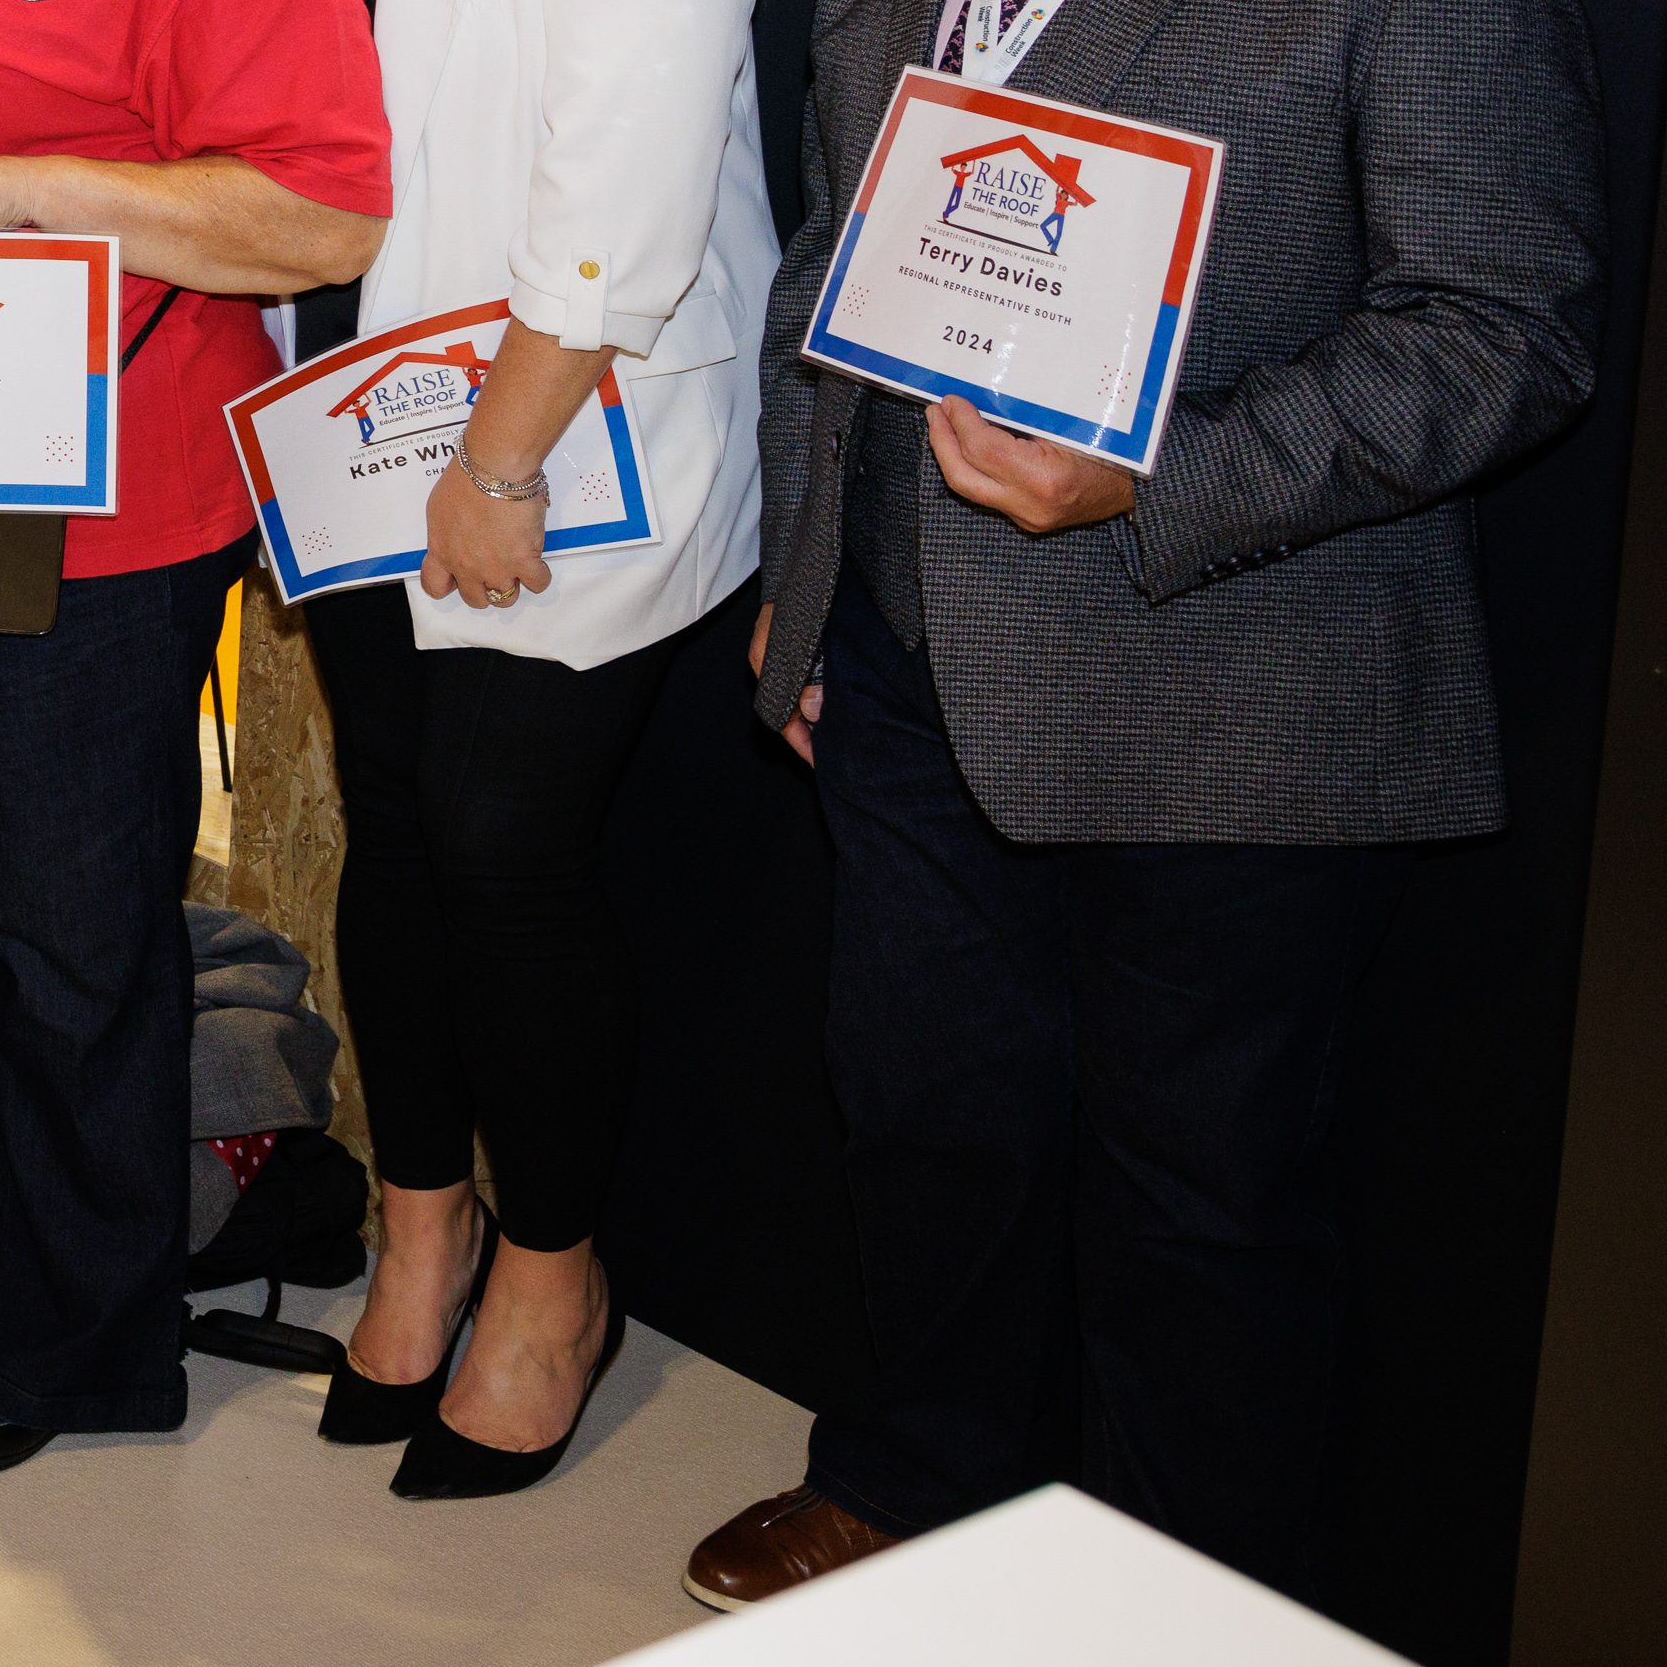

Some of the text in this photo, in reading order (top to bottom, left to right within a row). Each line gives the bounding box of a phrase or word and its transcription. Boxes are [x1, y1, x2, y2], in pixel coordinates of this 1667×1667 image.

[983, 5, 991, 42] Construction
[1005, 18, 1034, 56] Construction
[1010, 40, 1025, 57] Week
[974, 161, 1047, 201] RAISE
[972, 187, 1039, 217] THE ROOF
[919, 237, 1063, 297] Terry Davies
[898, 265, 1072, 326] REGIONAL REPRESENTATIVE SOUTH
[942, 325, 994, 355] 2024
[371, 368, 455, 406] RAISE
[379, 389, 458, 417] THE ROOF
[349, 454, 408, 480] Kate
